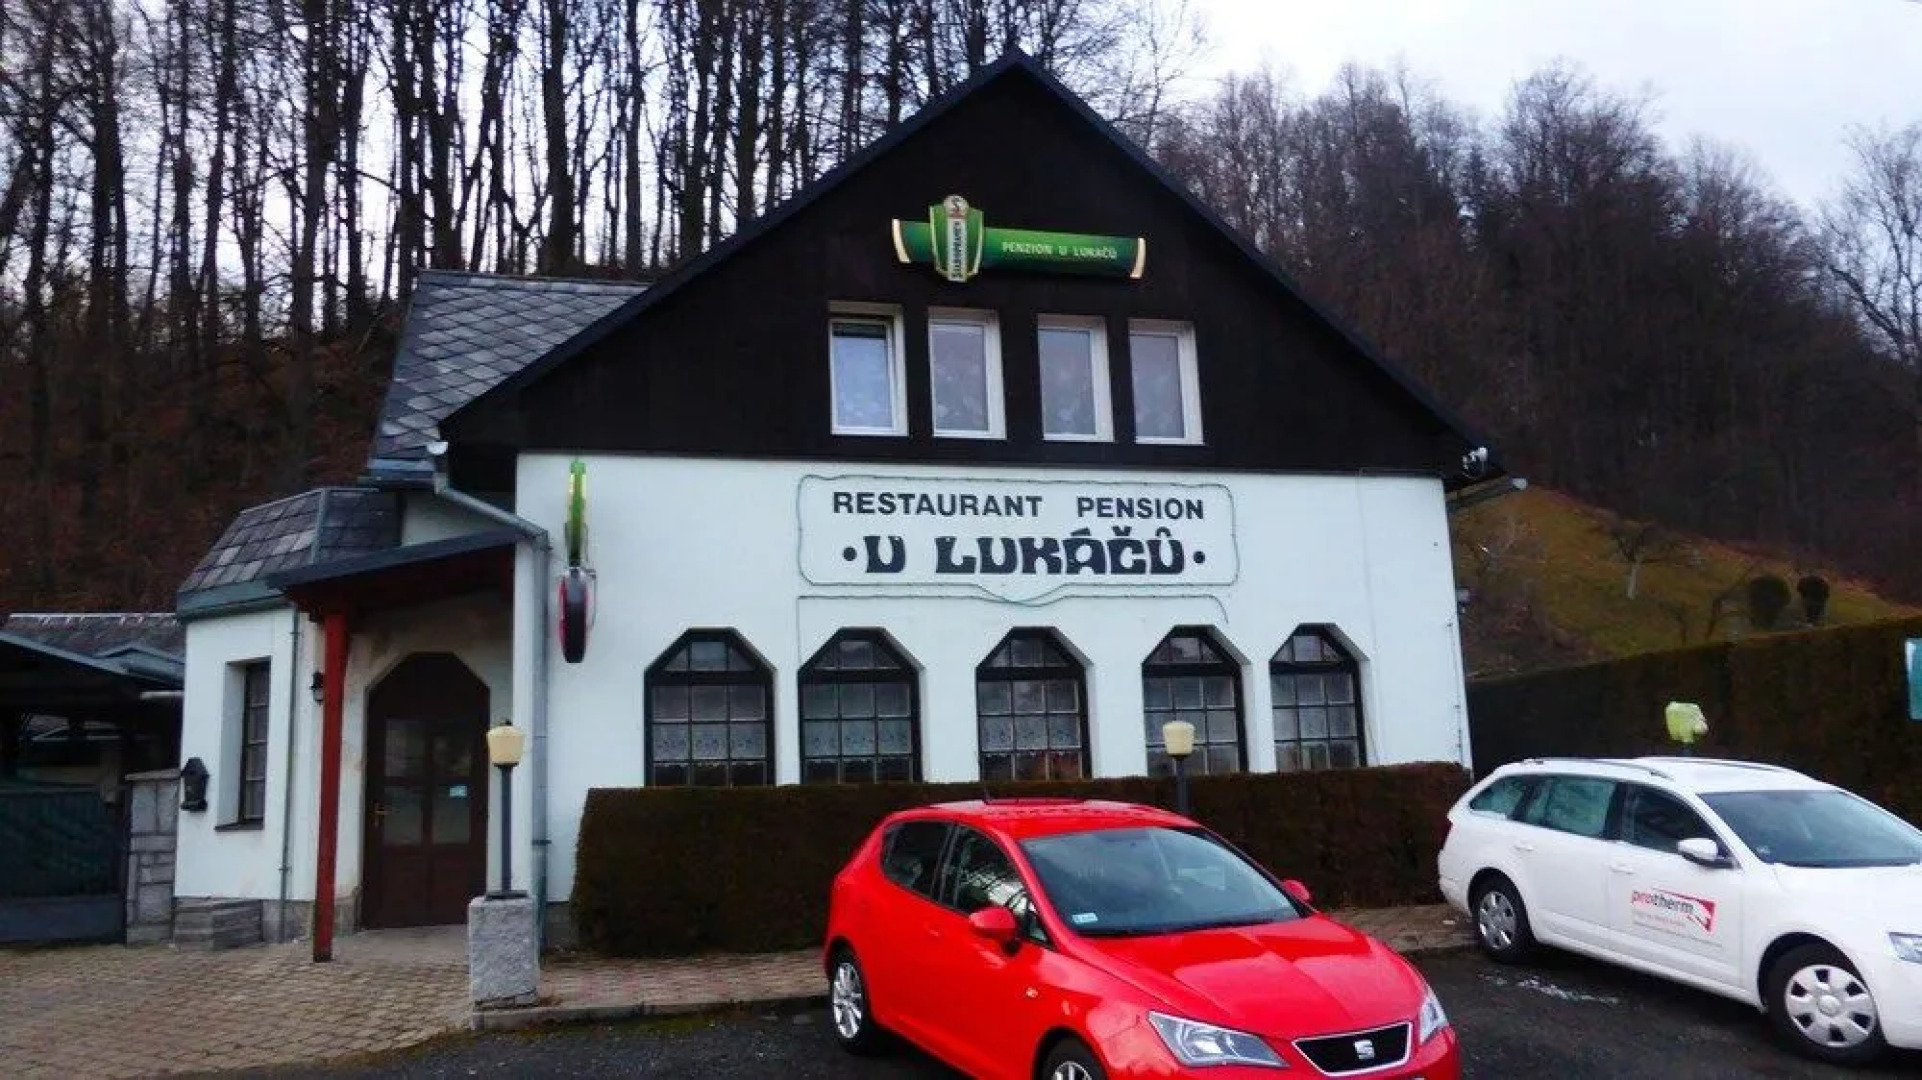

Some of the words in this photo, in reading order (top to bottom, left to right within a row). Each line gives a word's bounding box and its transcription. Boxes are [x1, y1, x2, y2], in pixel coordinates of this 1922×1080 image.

[832, 491, 1042, 517] RESTAURANT
[1076, 496, 1204, 520] PENSION
[863, 535, 906, 574] U
[935, 526, 1185, 575] LUKÁČŮ
[1631, 889, 1694, 914] protherm
